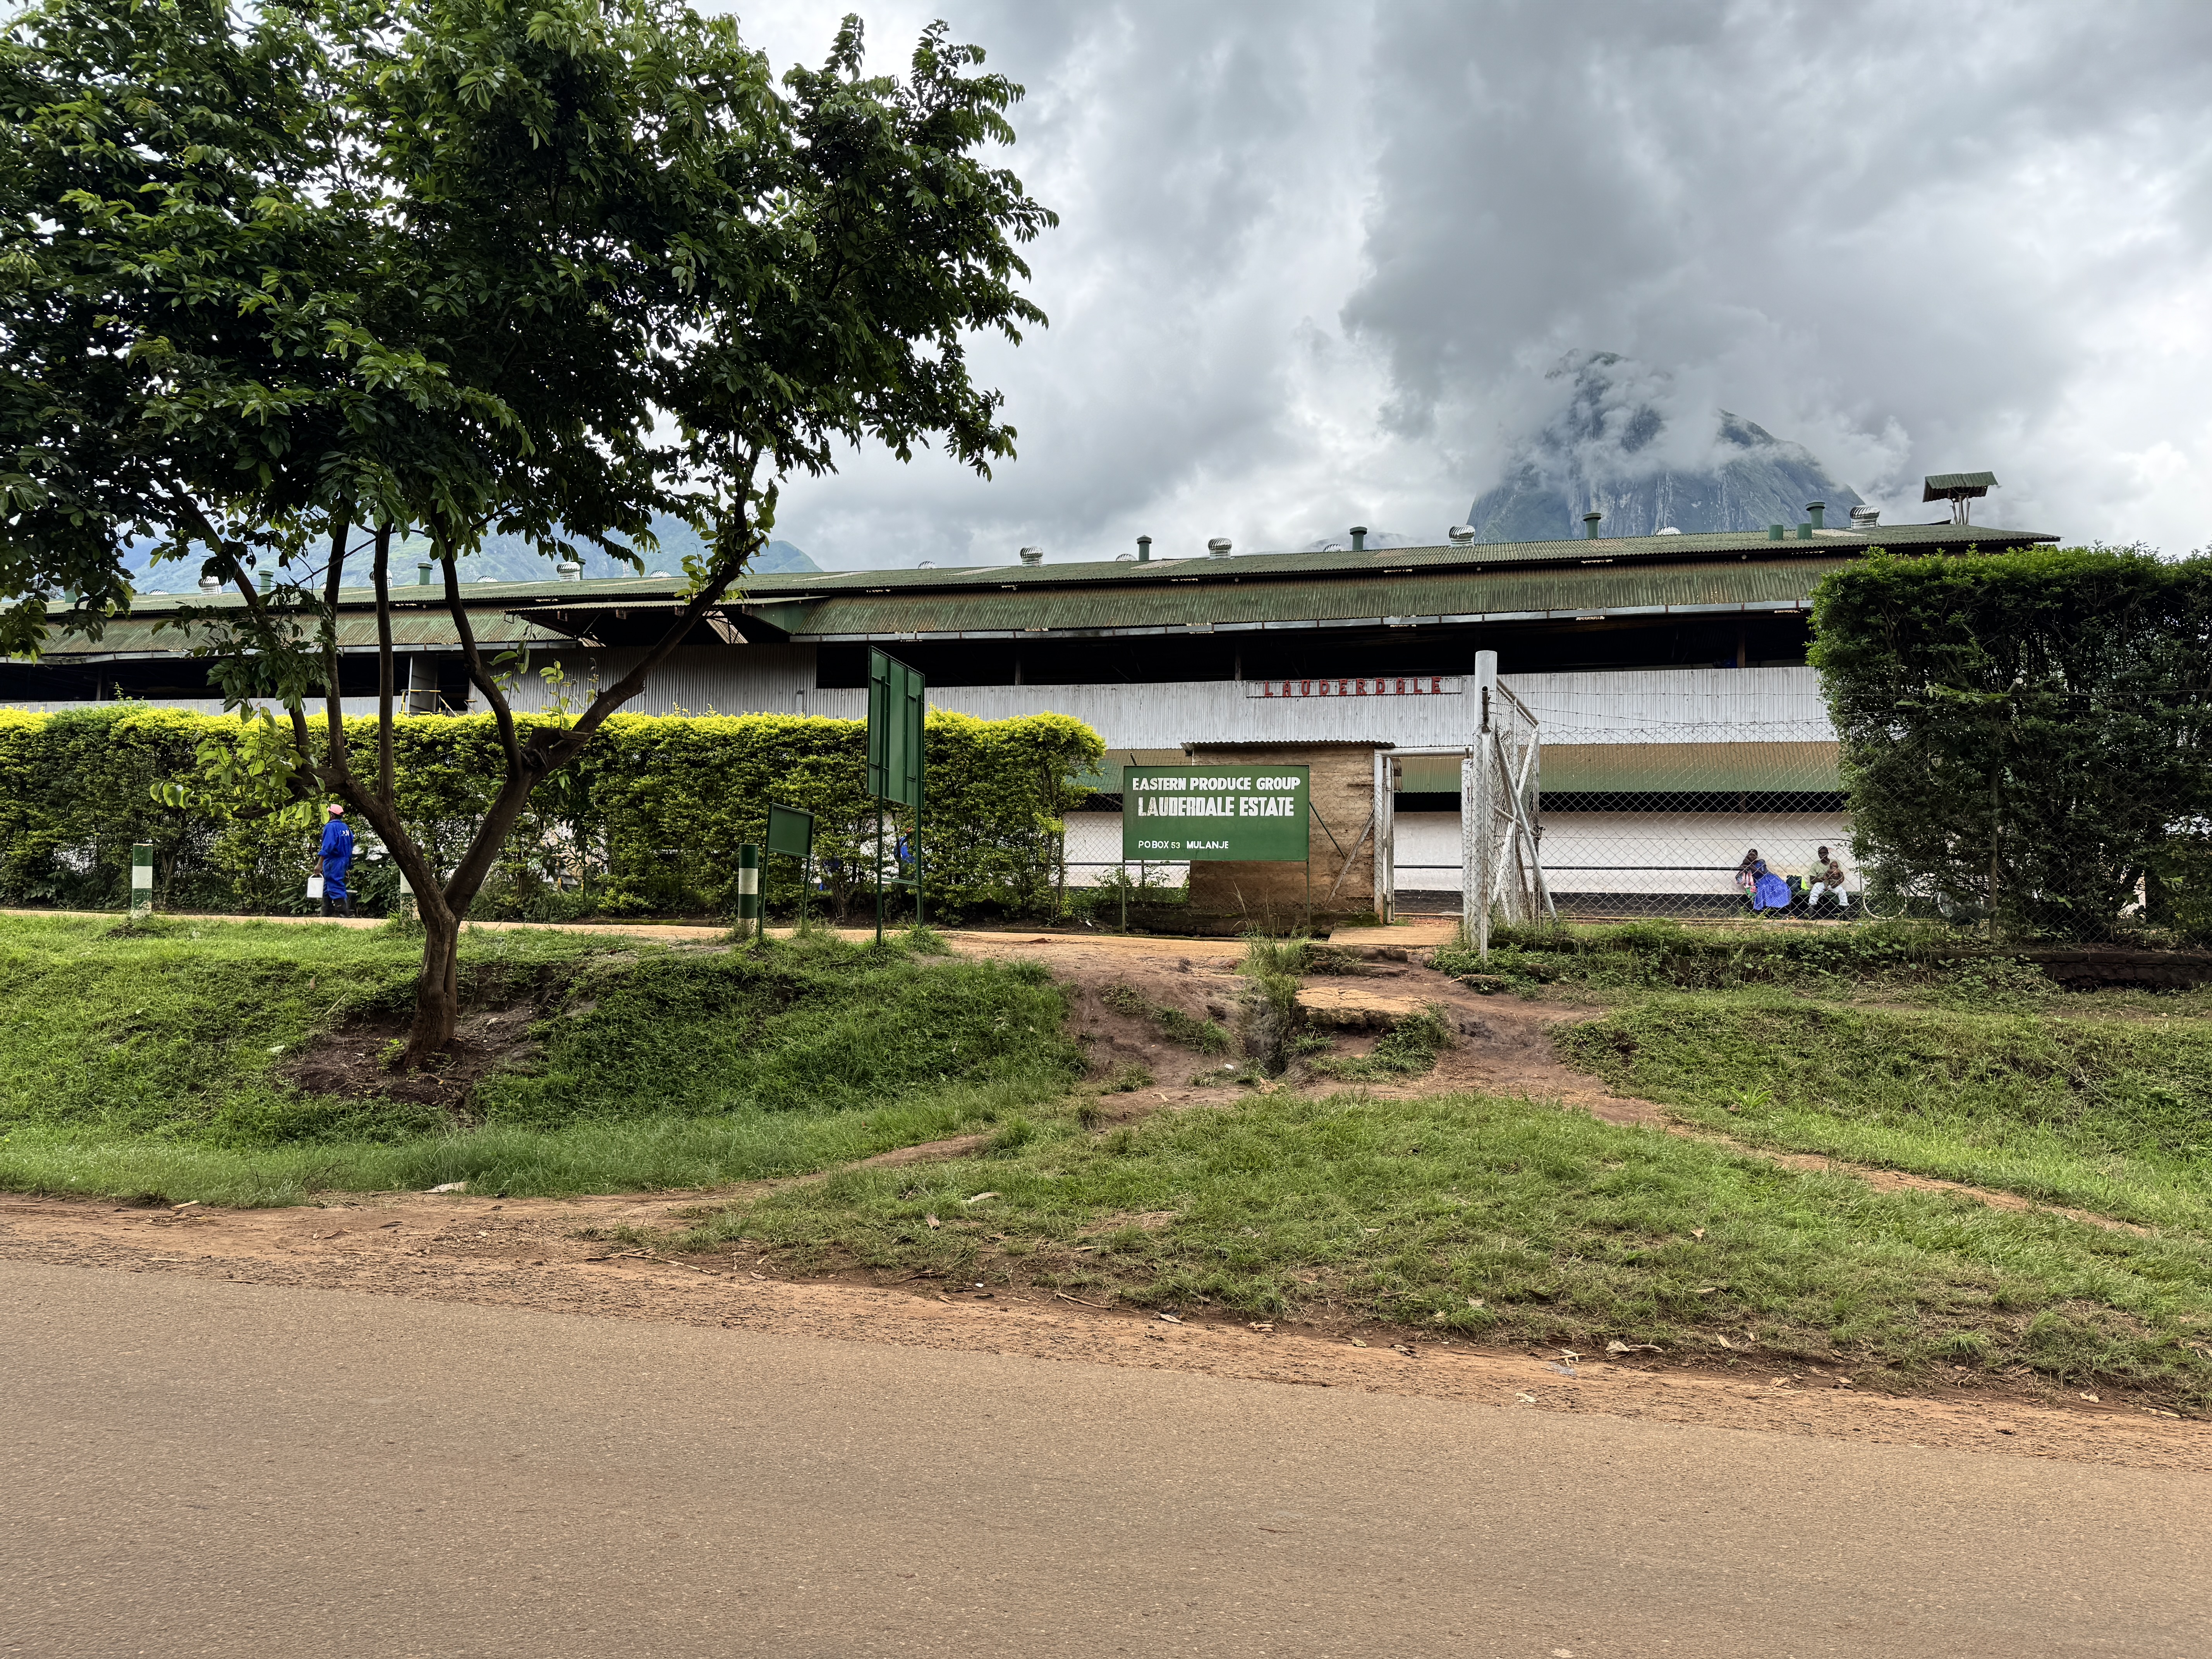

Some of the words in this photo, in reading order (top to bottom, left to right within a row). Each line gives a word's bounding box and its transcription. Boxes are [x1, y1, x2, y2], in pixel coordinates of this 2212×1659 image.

[1264, 677, 1441, 697] LAUDERDALE
[1132, 777, 1187, 791] EASTERN
[1190, 777, 1251, 790] PRODUCE
[1256, 777, 1301, 790] GROUP
[1138, 797, 1235, 816] LAUDERDALE
[1239, 797, 1294, 816] ESTATE
[1187, 840, 1229, 849] MULANJE
